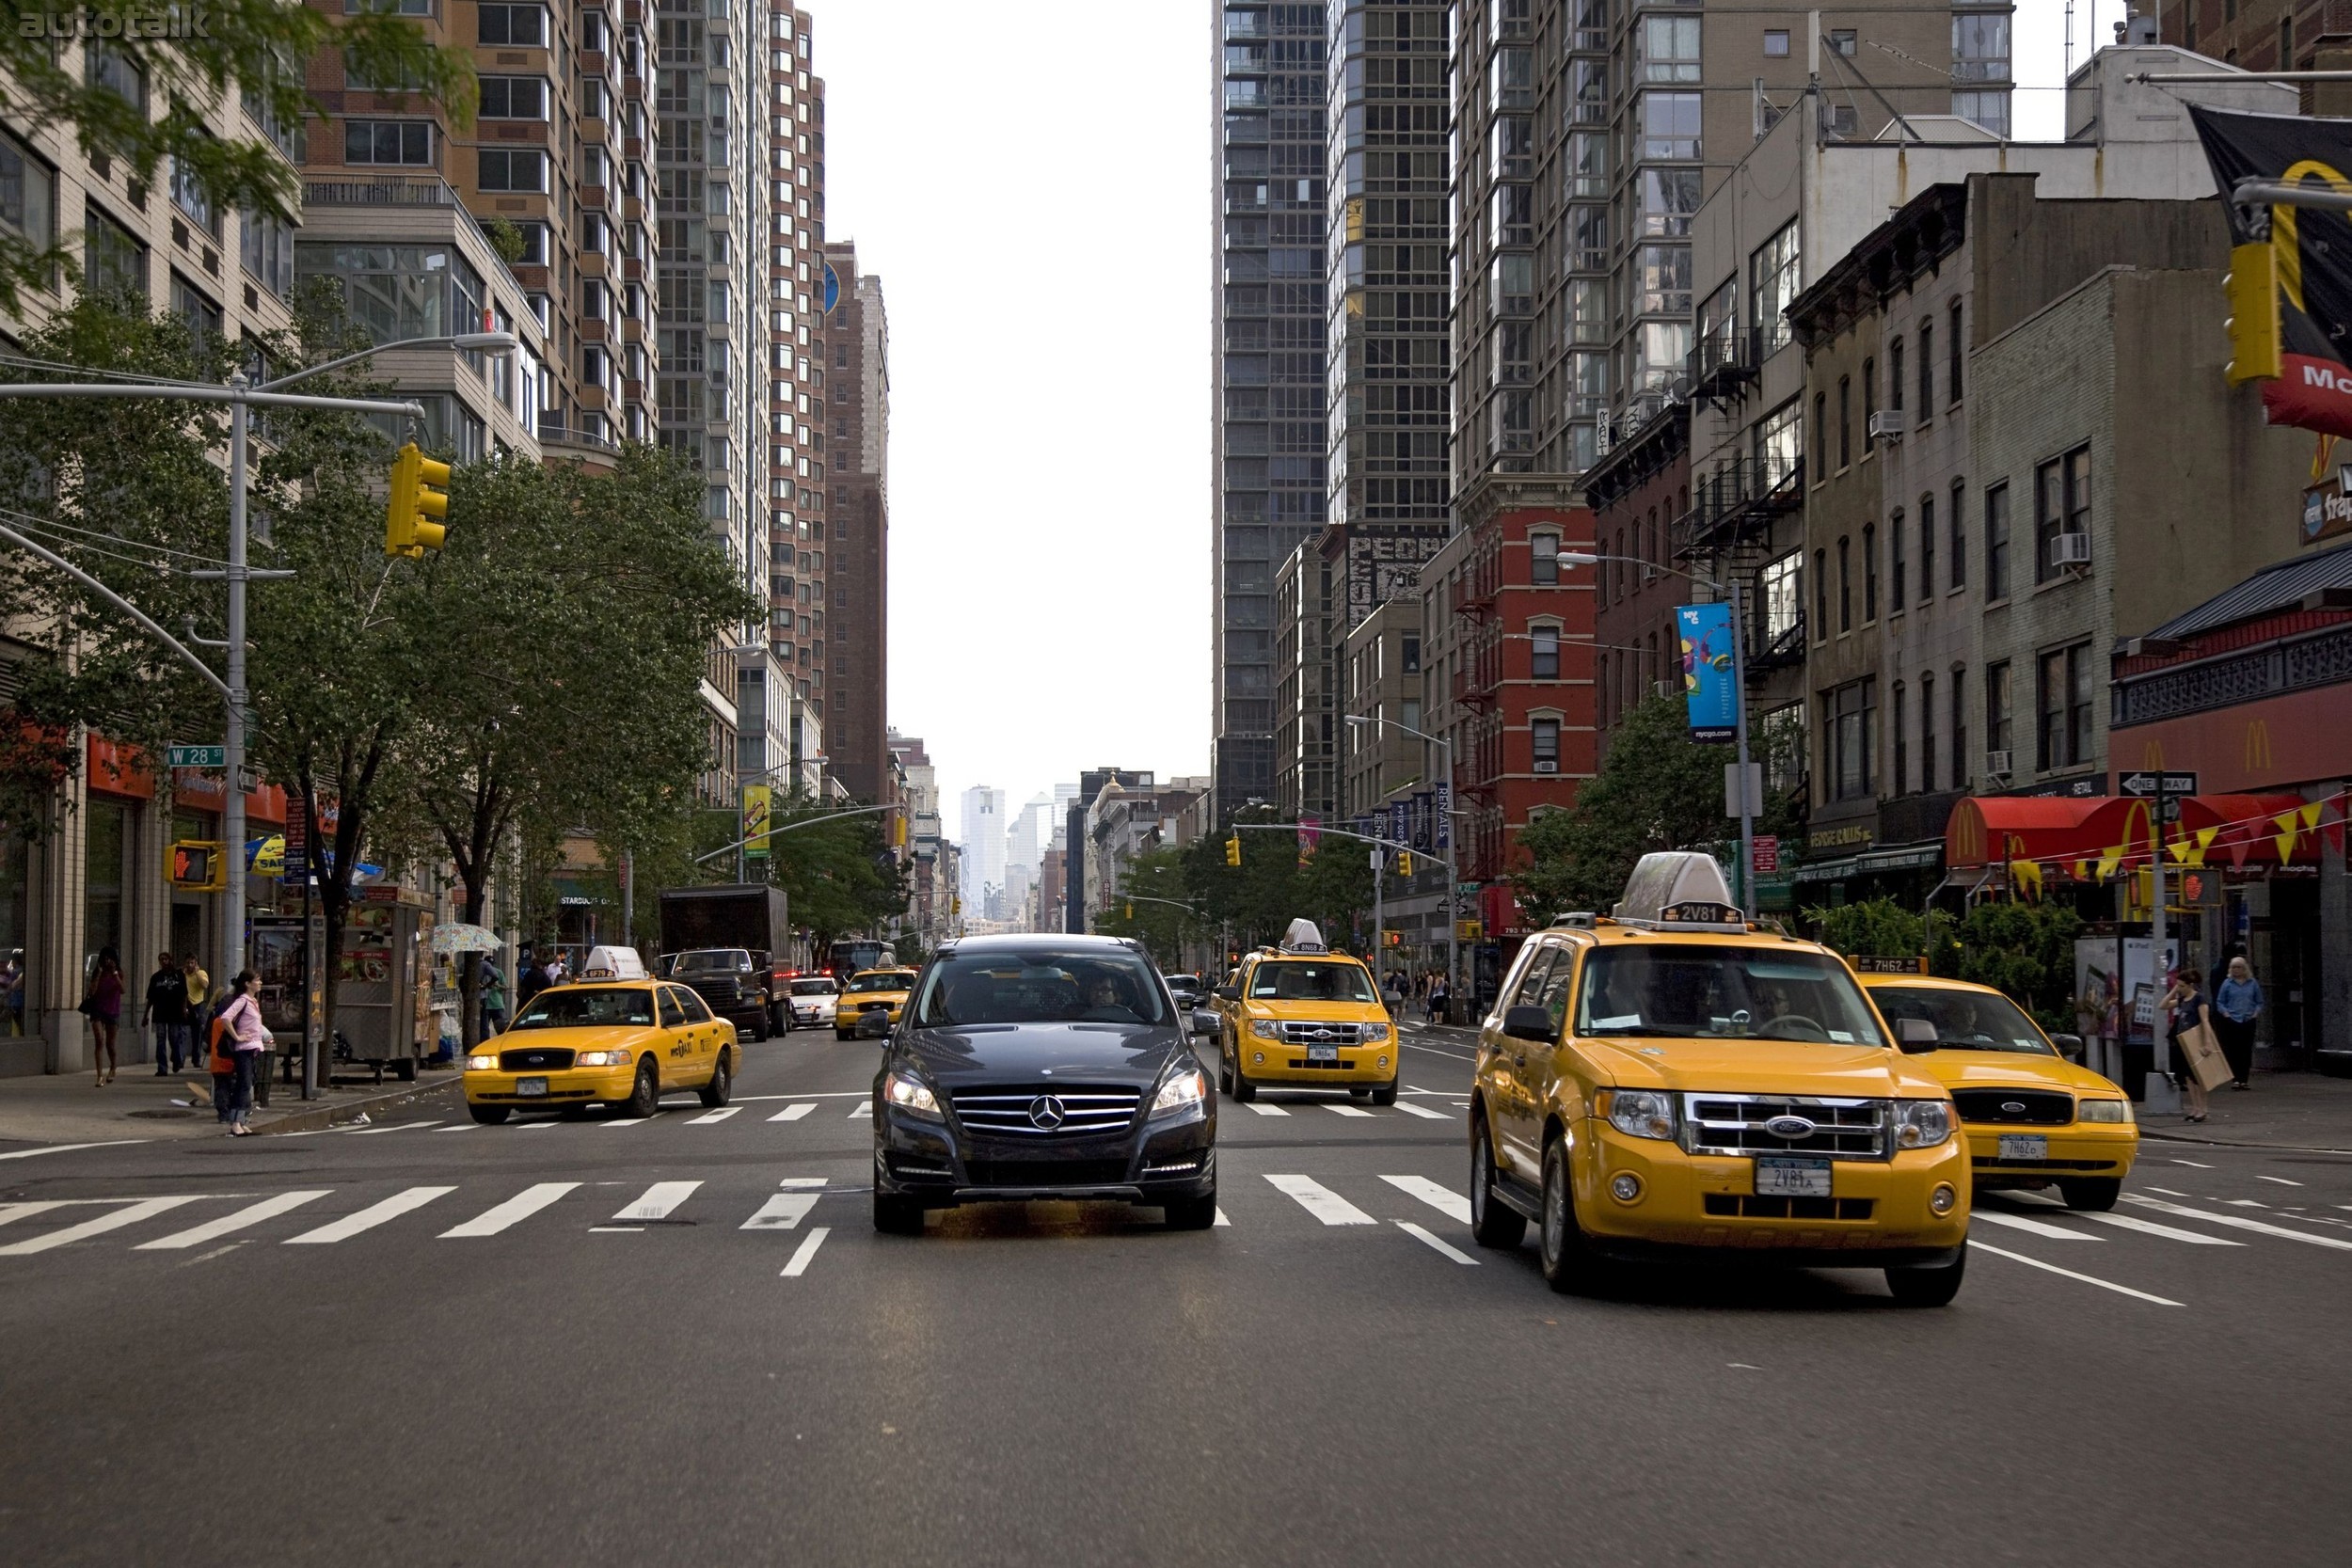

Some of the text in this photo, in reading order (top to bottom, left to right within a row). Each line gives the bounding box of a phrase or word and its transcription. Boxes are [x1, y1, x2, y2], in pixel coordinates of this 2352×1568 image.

[1695, 730, 1732, 738] nycgo.com
[172, 749, 222, 764] W 28 ST
[2130, 778, 2188, 789] ONE WAY
[1438, 788, 1449, 837] RENTALS
[1682, 906, 1717, 921] 2V81
[523, 949, 530, 958] P
[1301, 943, 1317, 952] 8N68
[1875, 959, 1903, 972] 7H62
